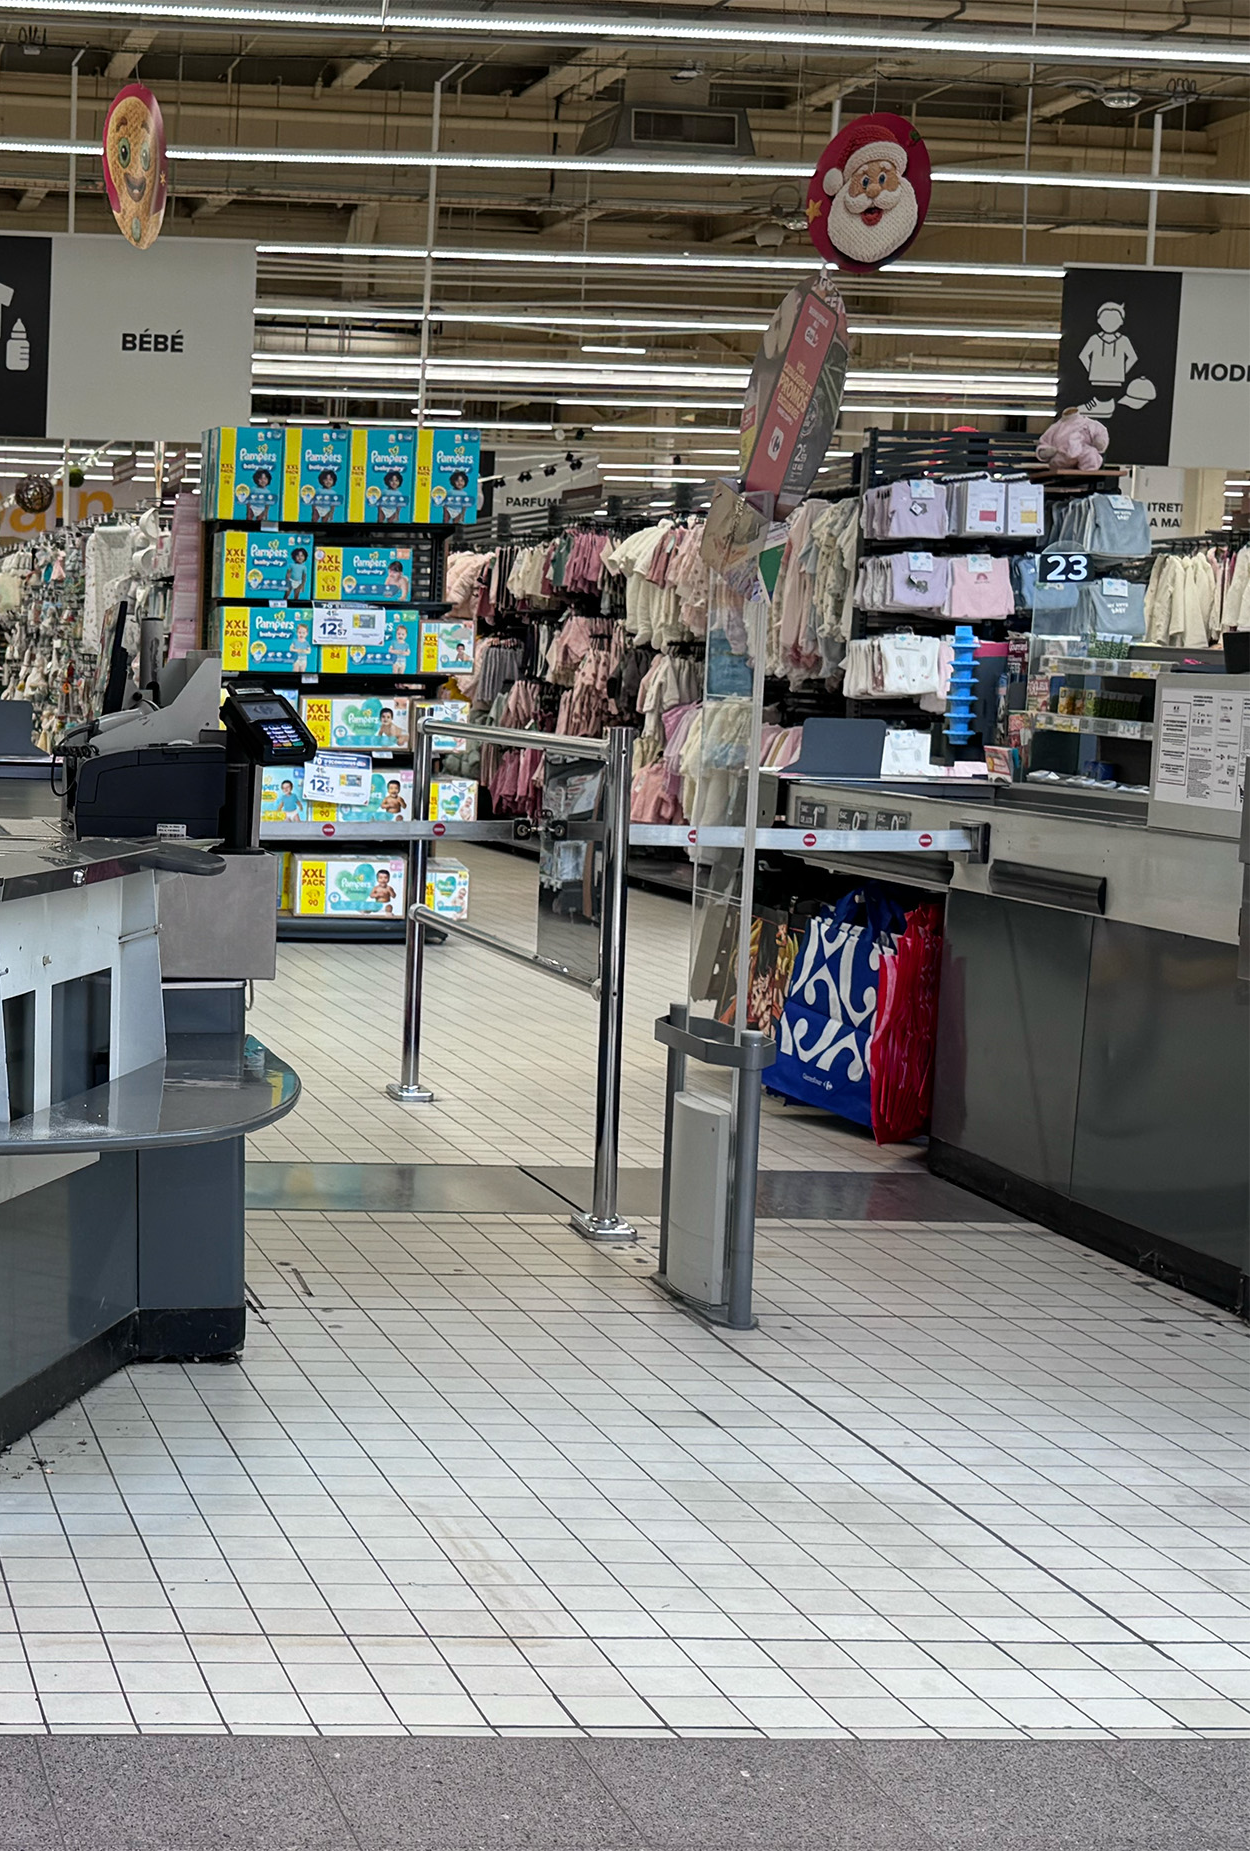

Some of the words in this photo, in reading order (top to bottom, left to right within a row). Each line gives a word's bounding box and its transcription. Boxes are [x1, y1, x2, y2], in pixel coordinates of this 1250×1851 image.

[121, 328, 184, 353] BÉBÉ
[1190, 362, 1250, 382] MOD
[240, 448, 276, 462] Pampers
[305, 449, 342, 463] Pampers
[371, 450, 408, 464] Pampers
[436, 451, 473, 464] Pampers
[251, 543, 288, 558] Pampers
[353, 555, 387, 568] Pampers
[1047, 554, 1088, 581] 23
[256, 616, 295, 631] Pampers
[307, 704, 330, 713] XXL
[307, 714, 331, 722] PACK
[302, 869, 326, 878] XXL
[308, 899, 318, 907] 90
